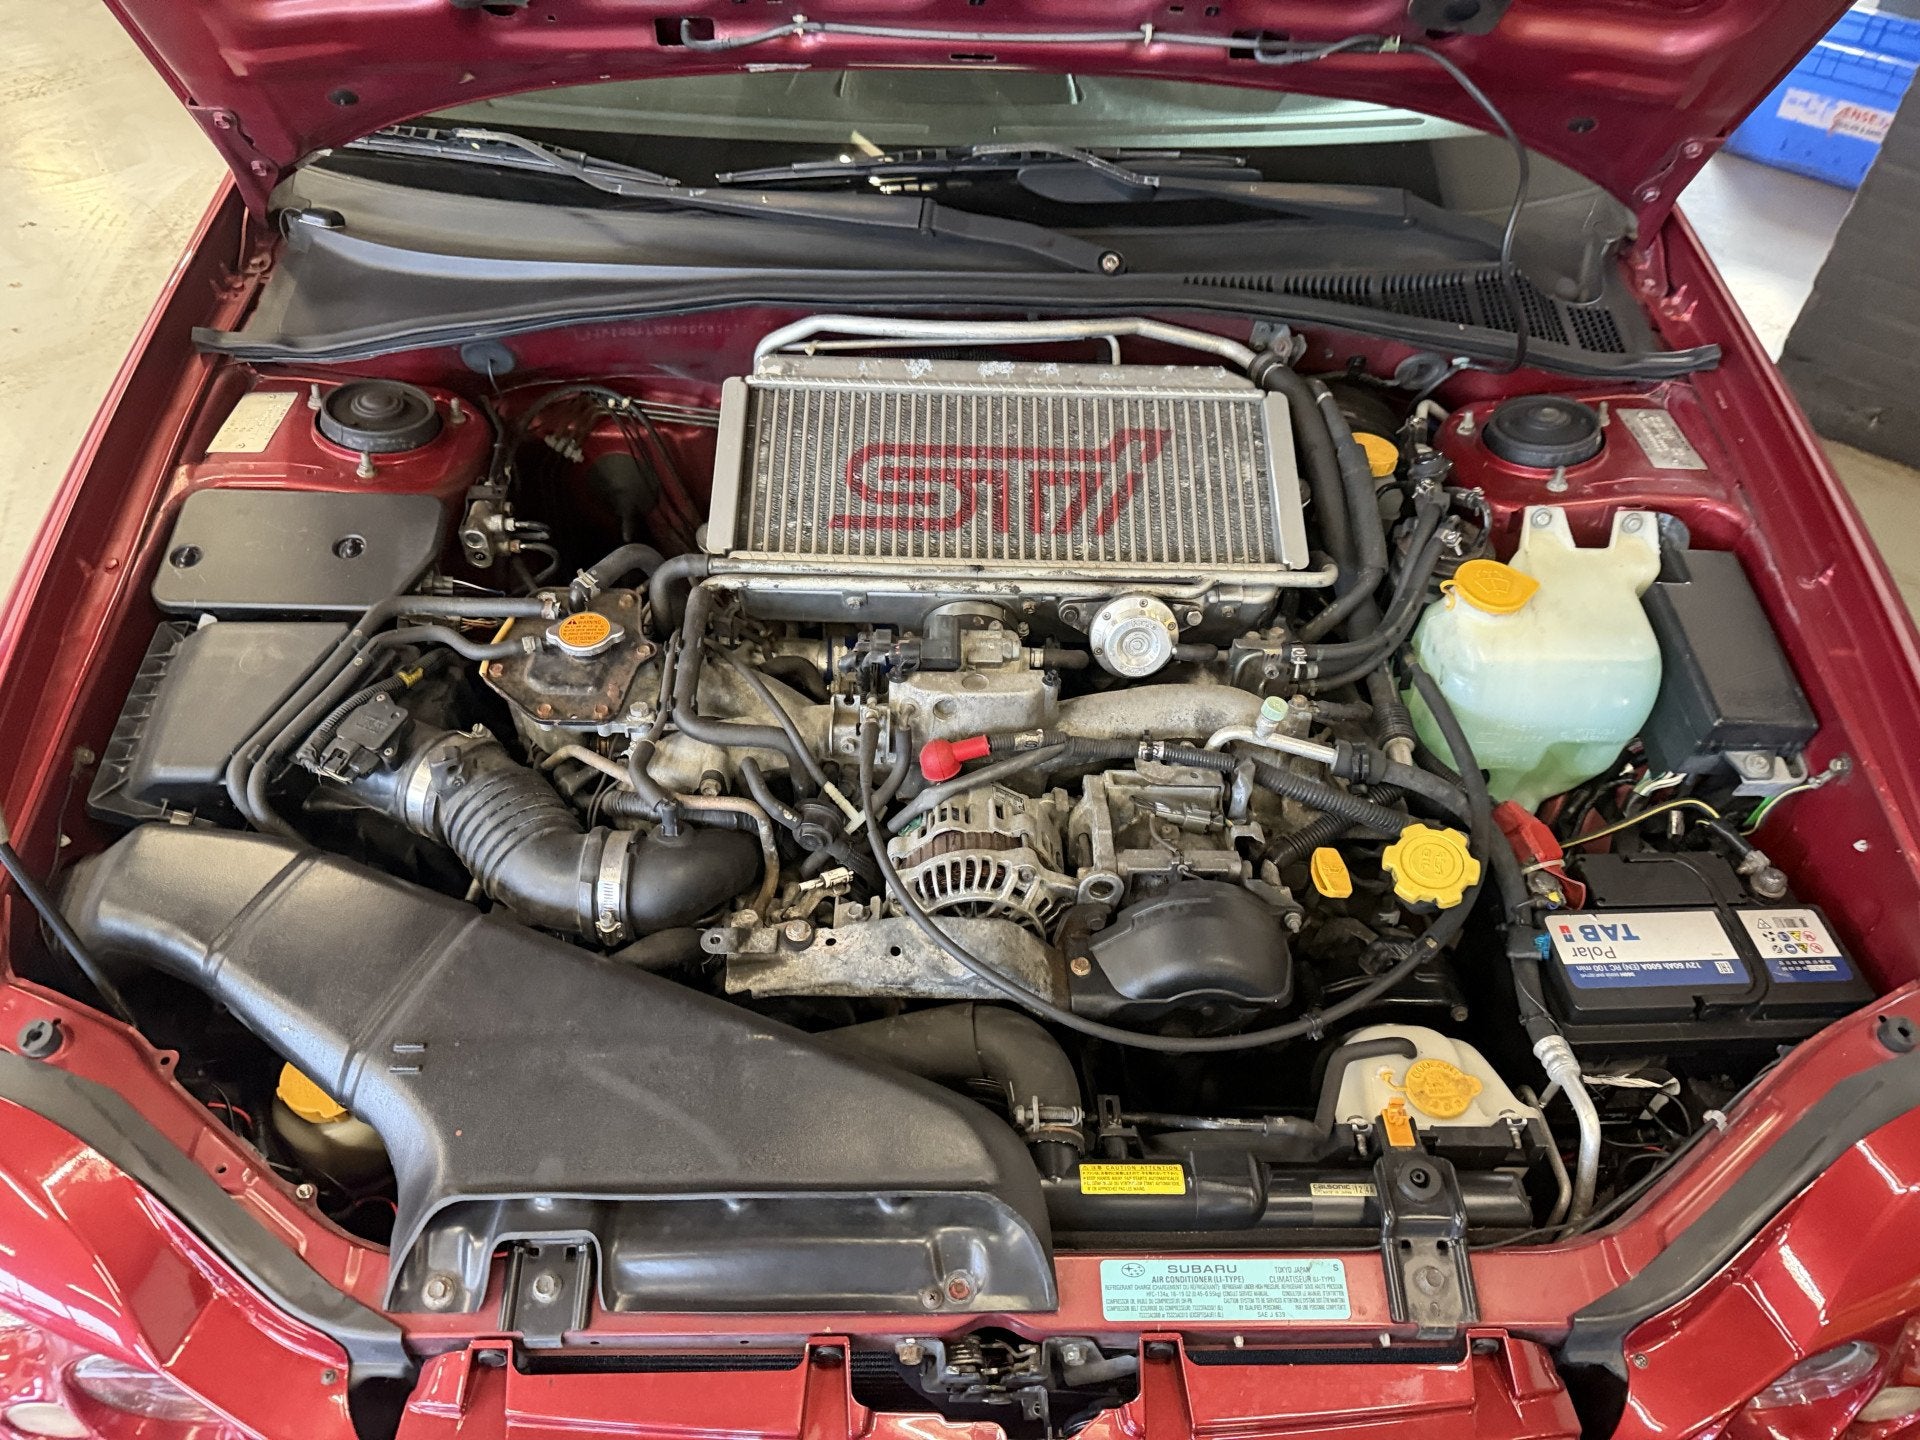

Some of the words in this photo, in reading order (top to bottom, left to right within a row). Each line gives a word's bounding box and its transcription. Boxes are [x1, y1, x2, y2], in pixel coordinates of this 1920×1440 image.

[1579, 924, 1640, 942] TAB
[1572, 946, 1617, 960] Polar
[1622, 962, 1640, 971] (EN)
[1168, 1264, 1237, 1273] SUBARU
